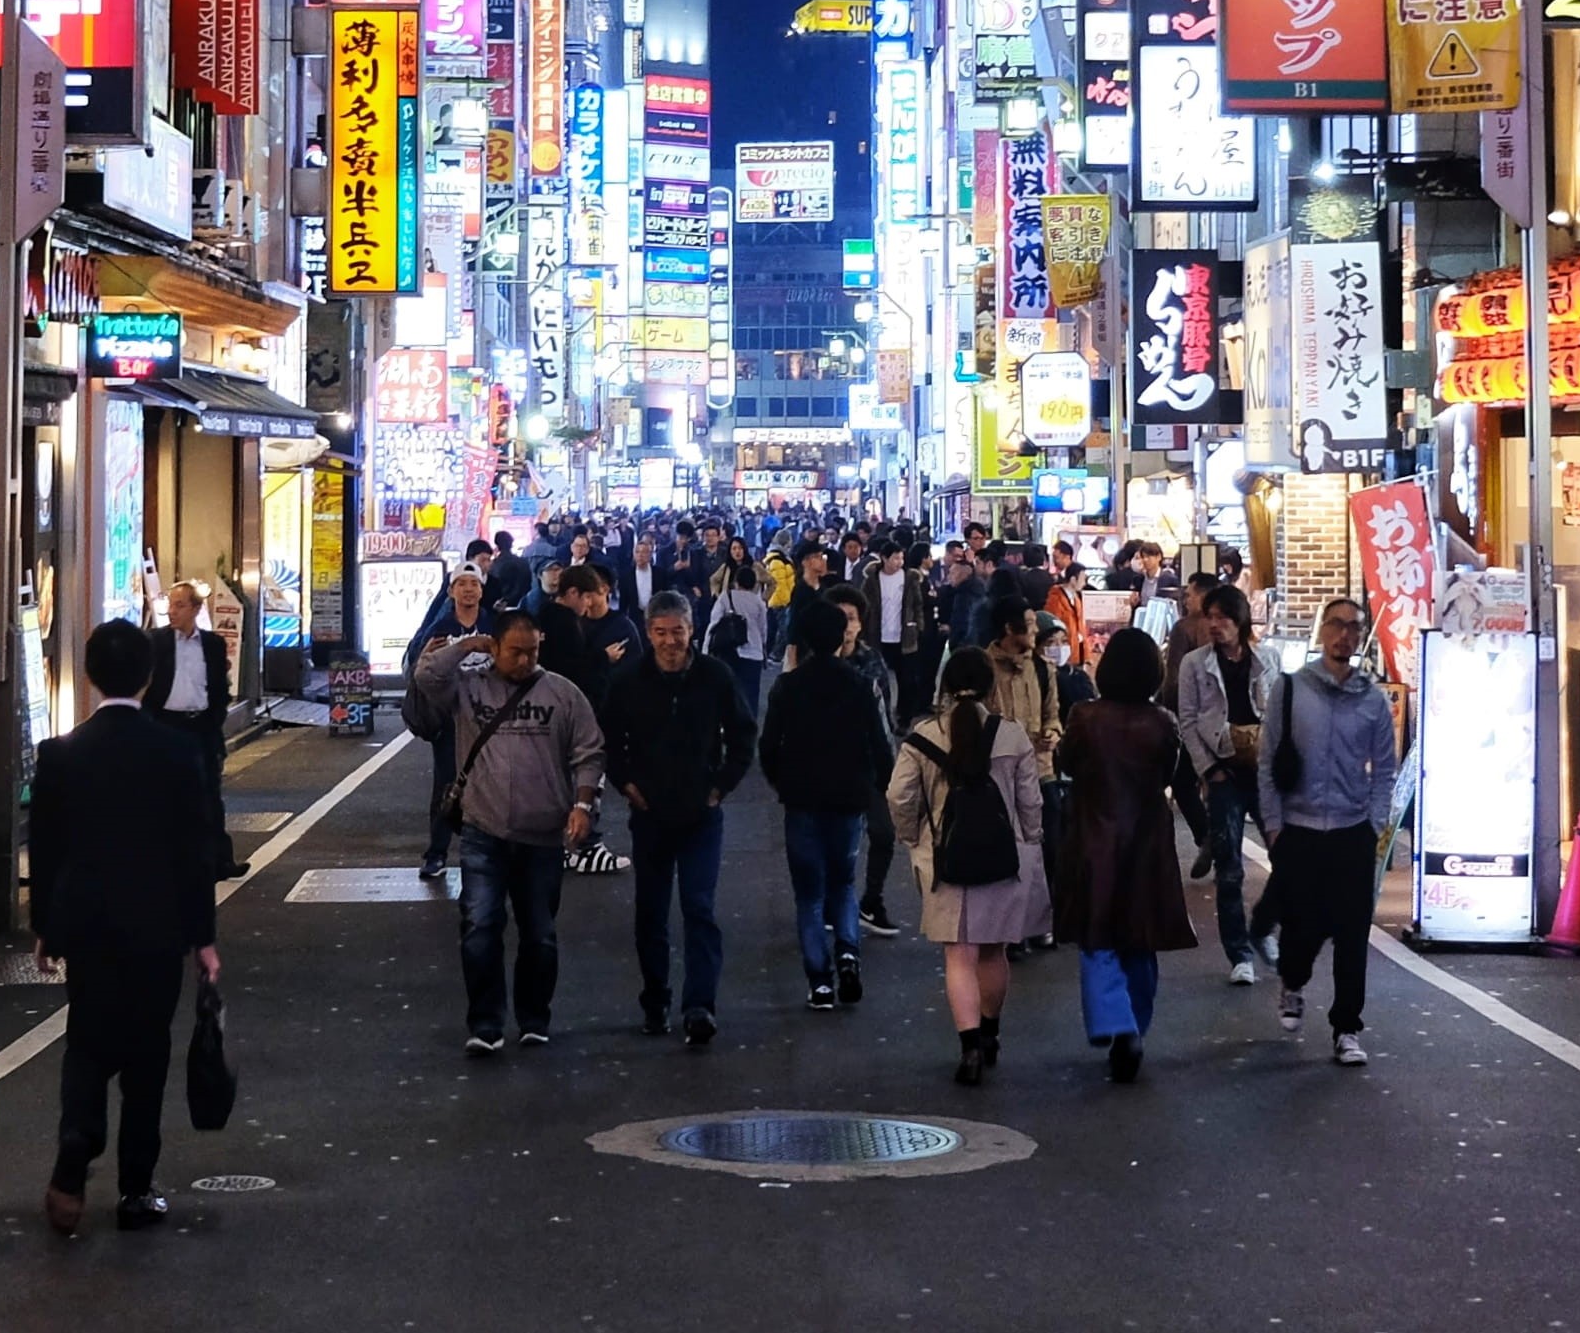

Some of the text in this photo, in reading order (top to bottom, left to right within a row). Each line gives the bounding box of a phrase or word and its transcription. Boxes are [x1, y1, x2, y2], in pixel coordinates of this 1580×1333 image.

[238, 1, 255, 111] ANRAKUTEI
[1294, 81, 1319, 98] B1
[31, 70, 52, 195] 劇場通り一番街
[1181, 262, 1212, 374] 東京豚骨
[1300, 260, 1320, 410] HIROSHIMA TEPPANYAKI
[1323, 257, 1380, 422] お好み焼き
[116, 358, 152, 376] Bar
[1342, 448, 1385, 468] B1F
[365, 532, 408, 557] 19:00
[333, 669, 366, 686] AKB
[346, 702, 371, 725] 3F
